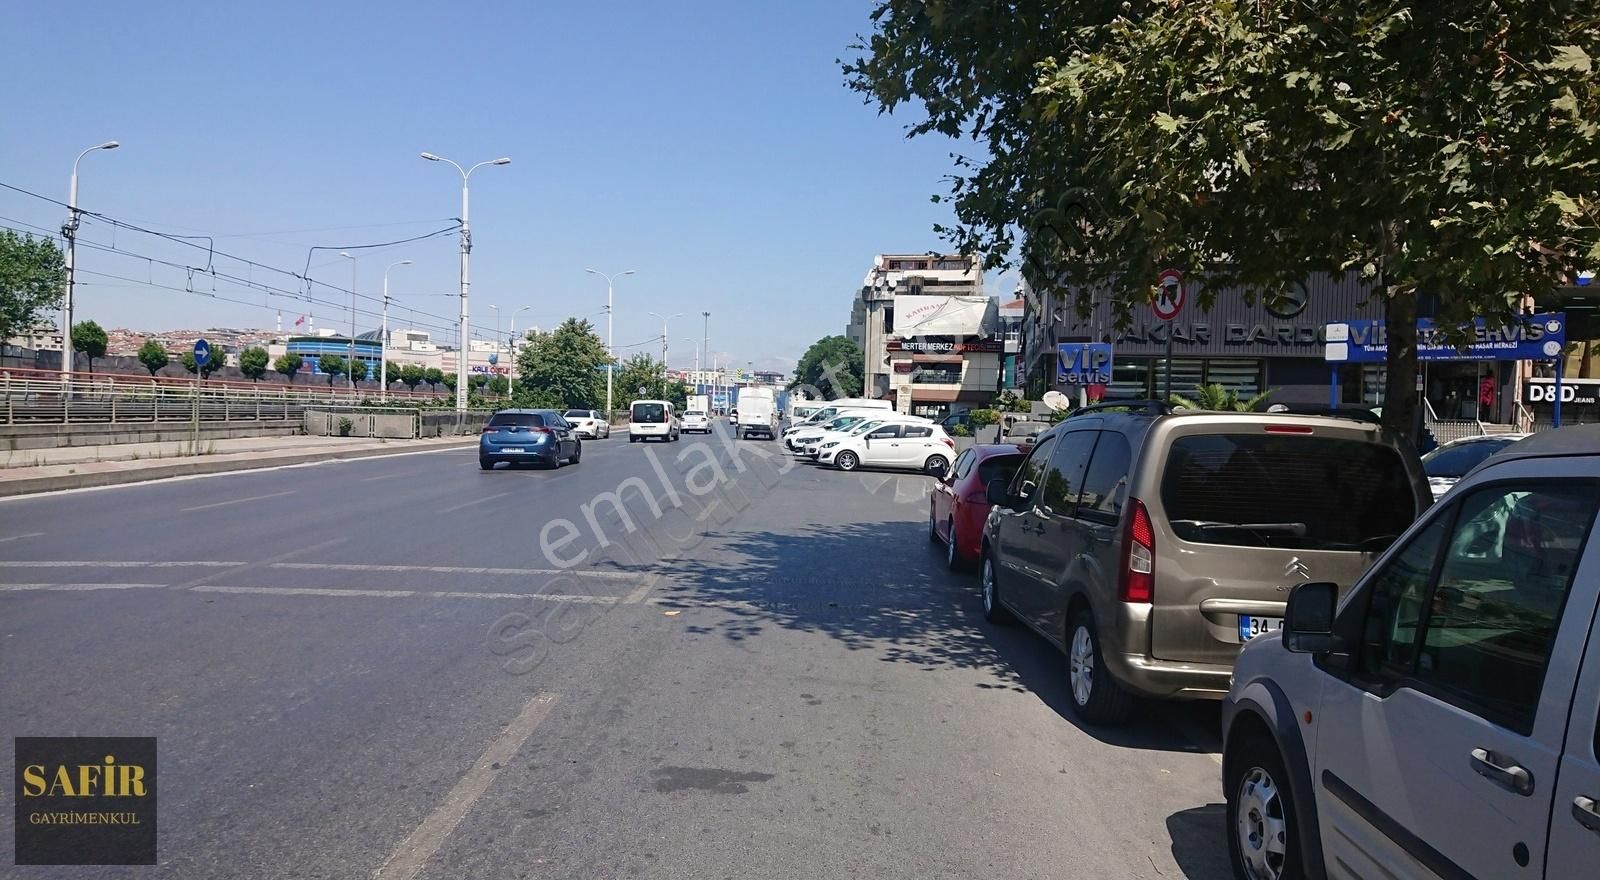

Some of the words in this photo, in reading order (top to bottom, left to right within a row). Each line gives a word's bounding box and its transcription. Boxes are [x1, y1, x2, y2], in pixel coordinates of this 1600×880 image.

[1059, 344, 1109, 369] VİP
[1058, 370, 1109, 383] servis
[1251, 618, 1268, 635] 34
